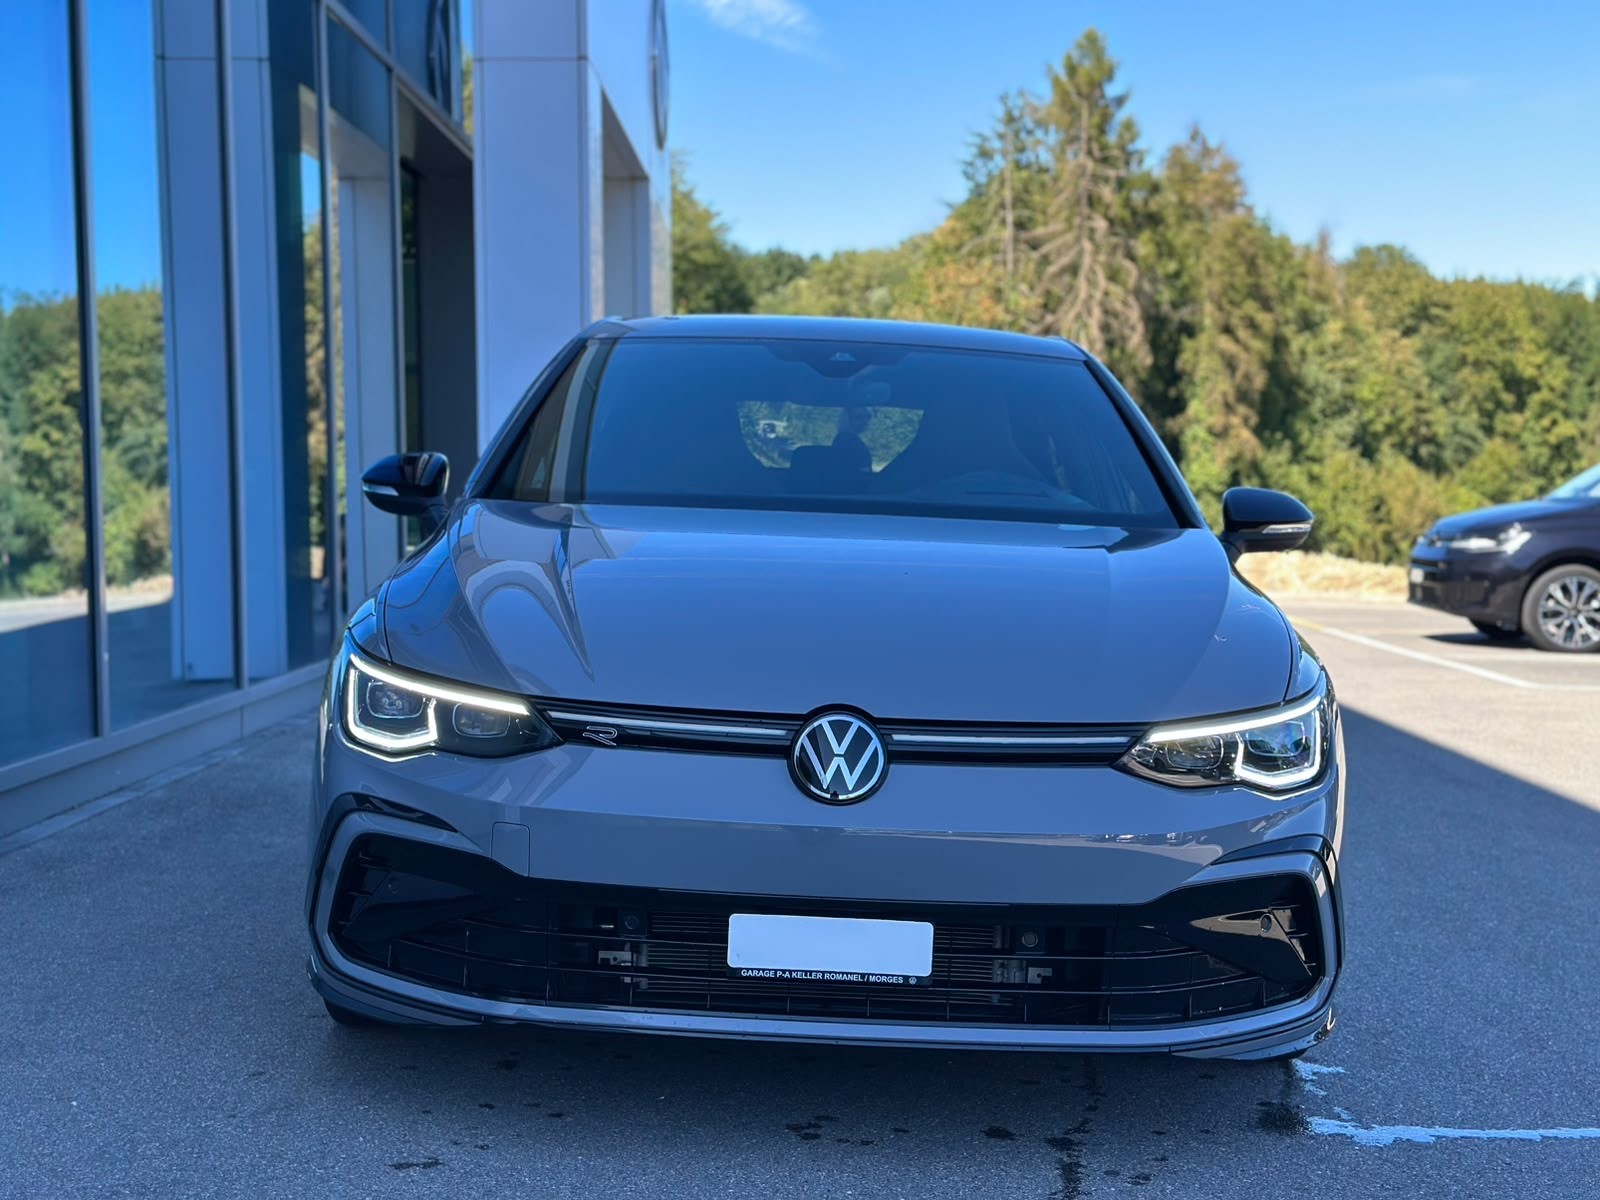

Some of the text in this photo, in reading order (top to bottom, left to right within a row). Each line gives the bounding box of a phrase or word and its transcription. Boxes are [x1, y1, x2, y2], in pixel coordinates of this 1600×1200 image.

[798, 716, 881, 794] VW
[741, 969, 775, 978] GARAGE
[791, 971, 823, 980] KELLER
[824, 973, 863, 982] ROMANEL
[869, 975, 903, 984] MORGES
